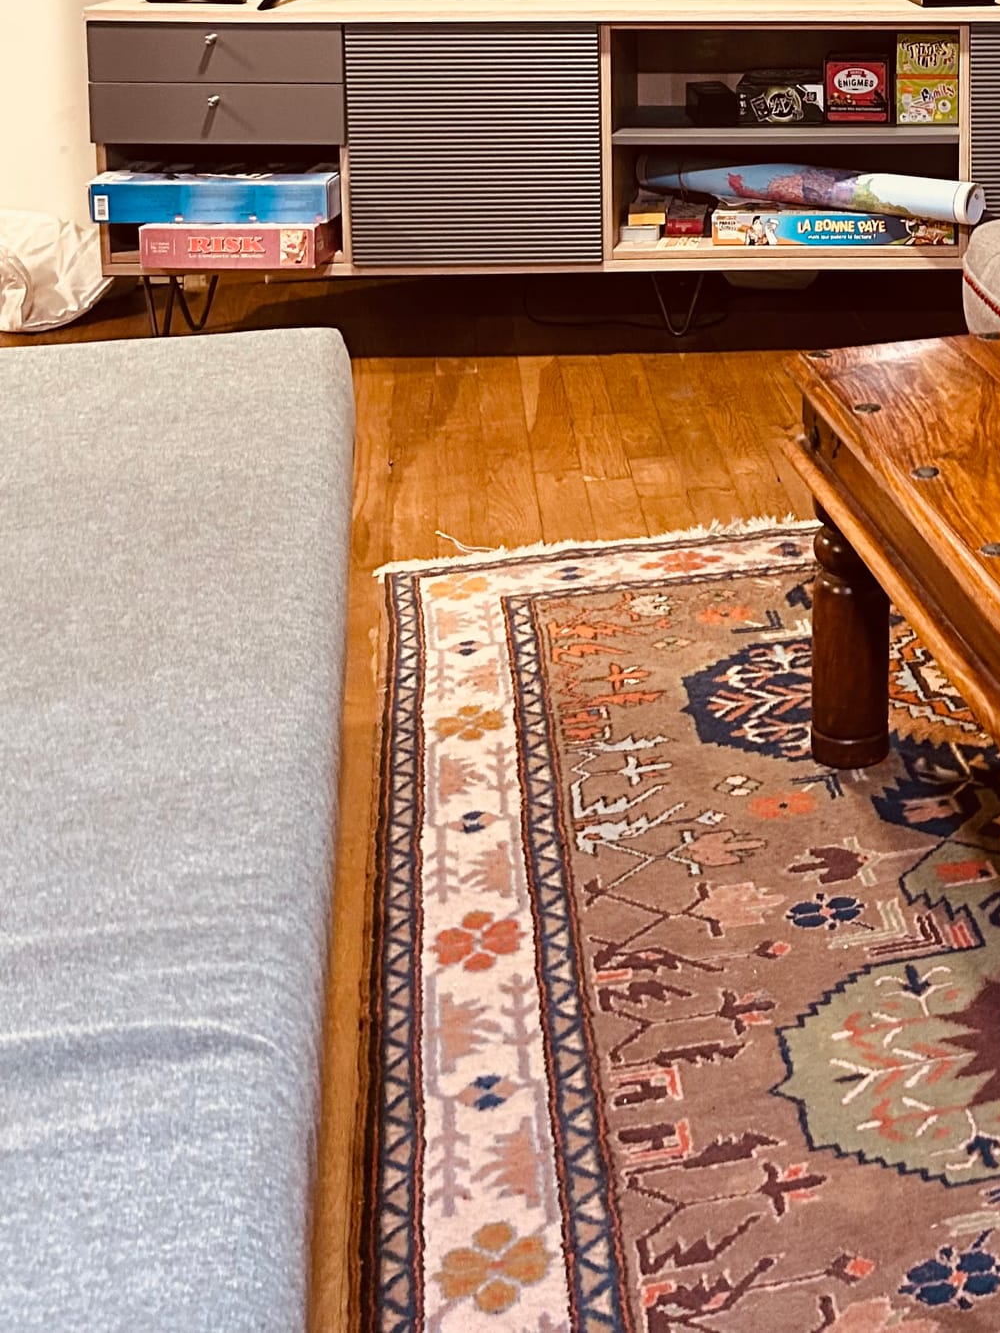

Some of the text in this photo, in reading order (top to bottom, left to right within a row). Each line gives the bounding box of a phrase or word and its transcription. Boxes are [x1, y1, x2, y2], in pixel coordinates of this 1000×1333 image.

[797, 219, 886, 234] LA BONNE PAYE
[188, 236, 266, 254] RISK
